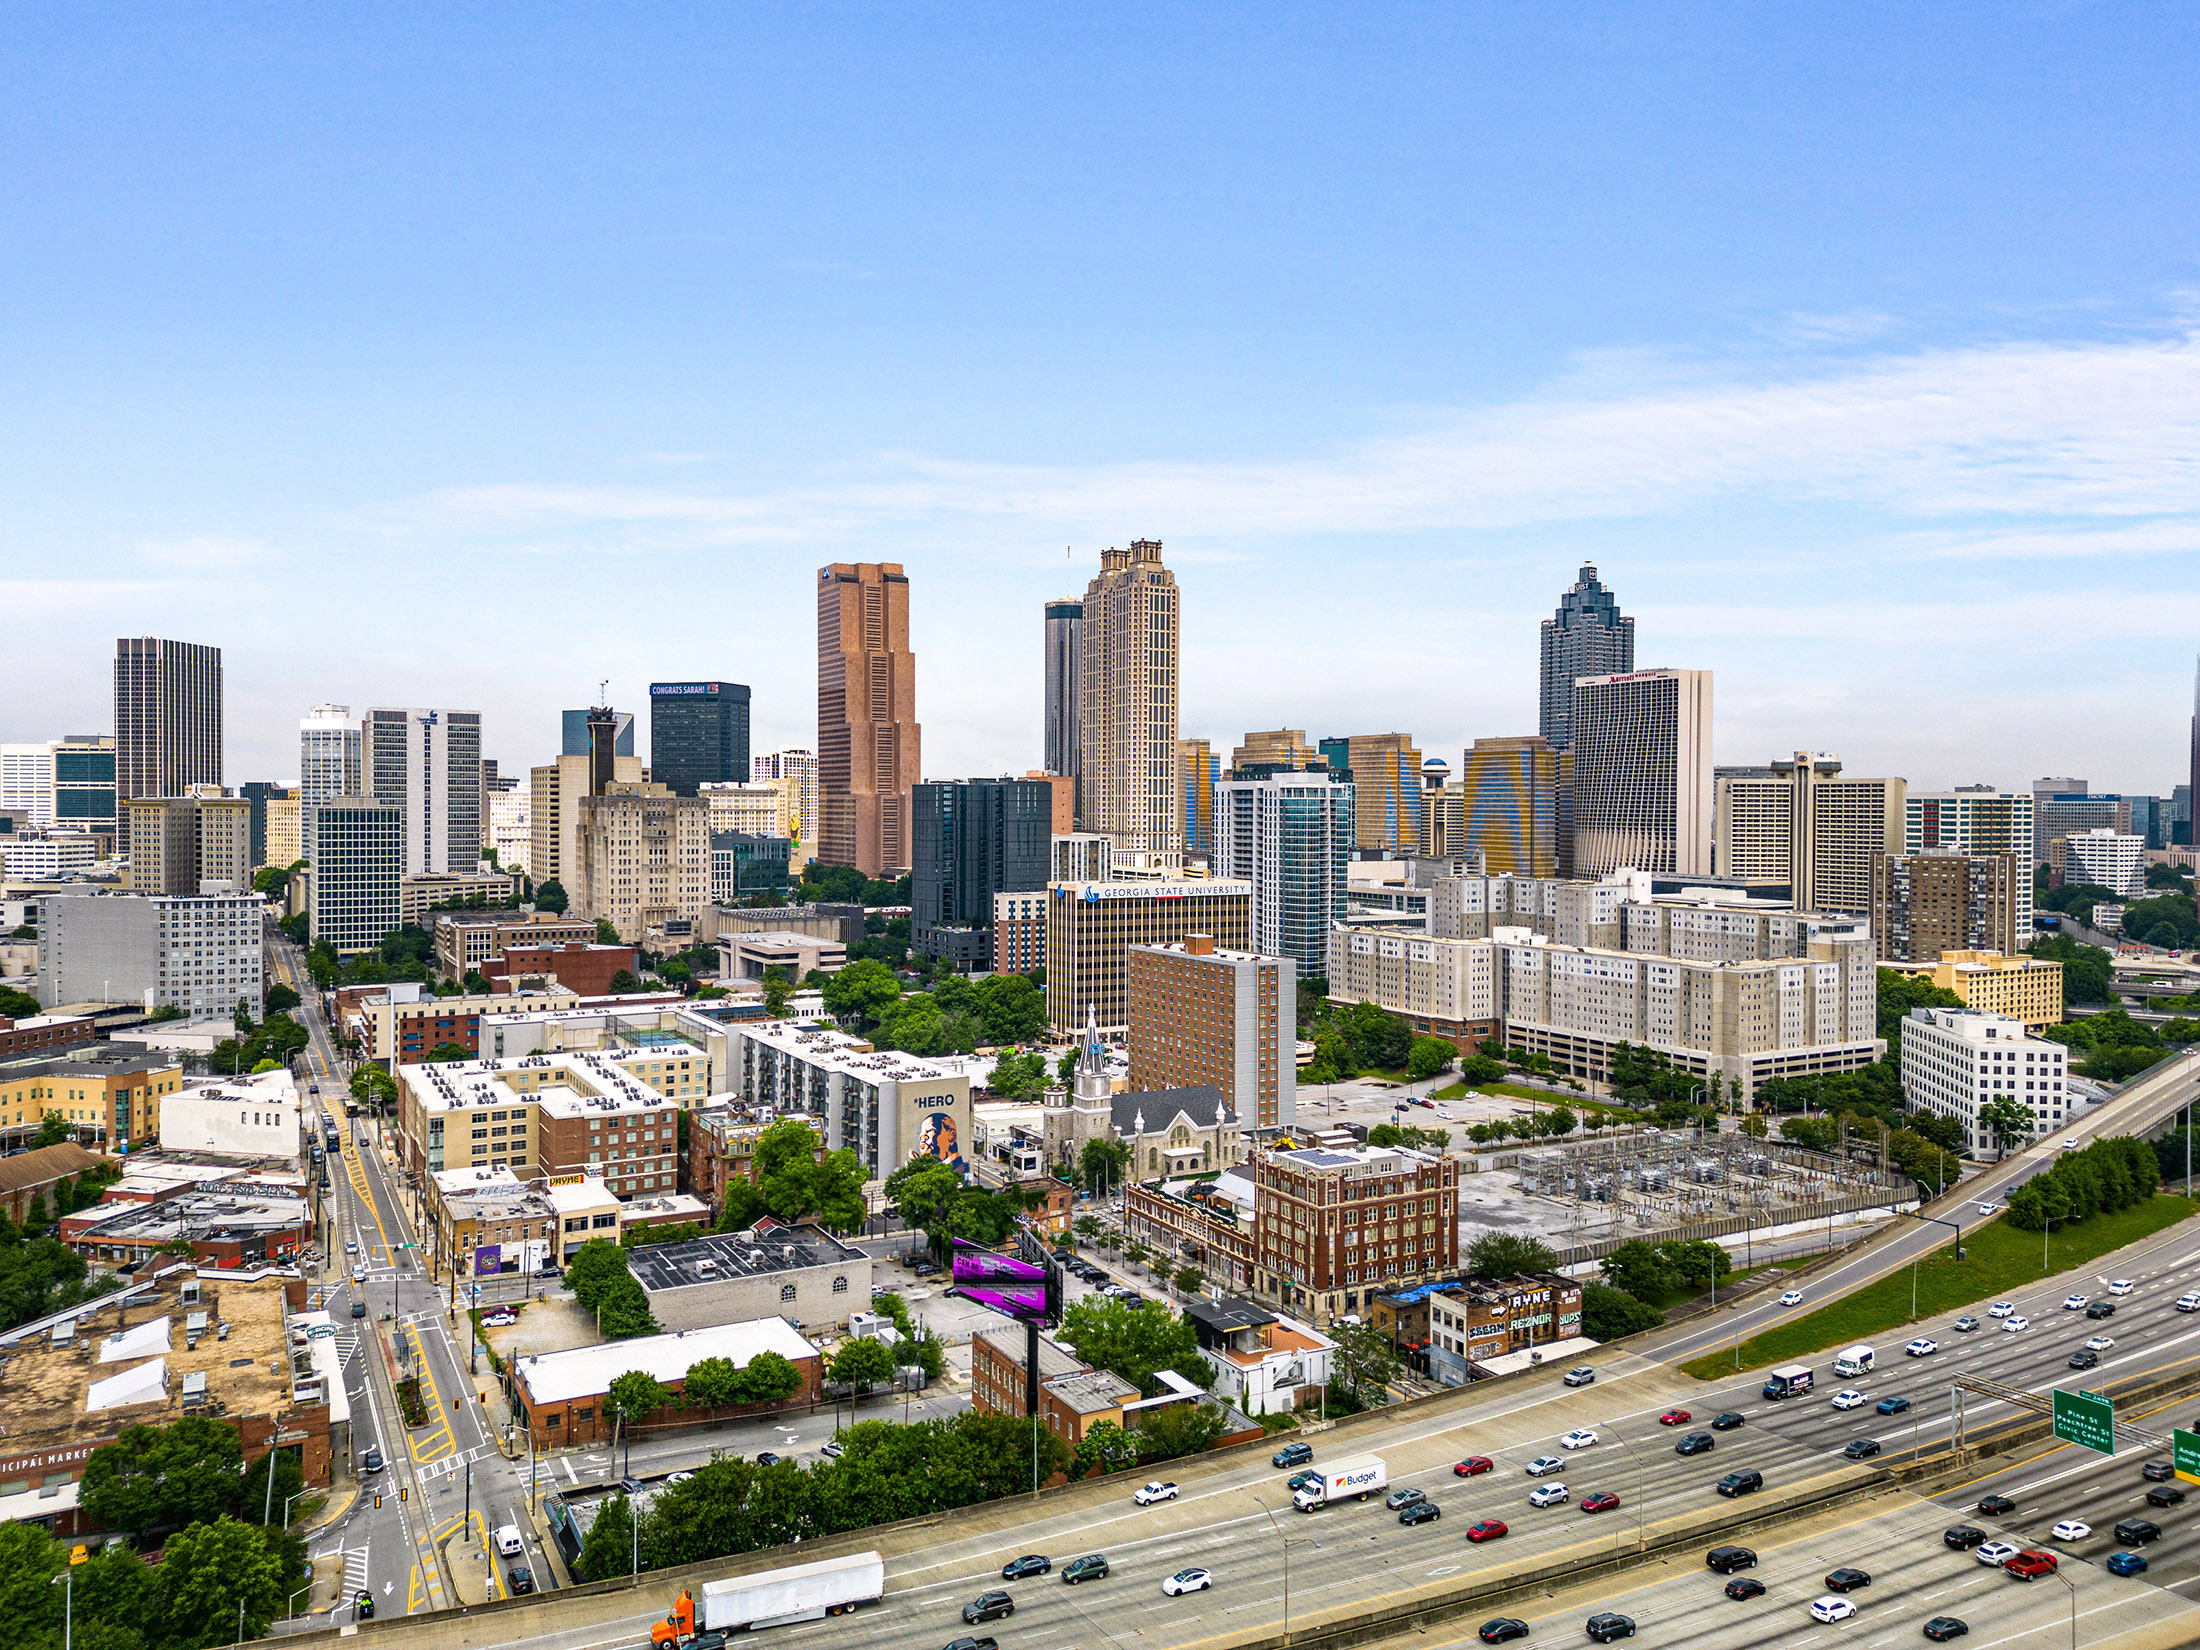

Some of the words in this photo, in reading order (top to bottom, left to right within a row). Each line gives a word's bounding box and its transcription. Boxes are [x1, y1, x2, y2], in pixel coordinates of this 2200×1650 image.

[1609, 674, 1634, 683] Marriott
[652, 686, 682, 694] CONGRATS
[683, 685, 705, 694] SARAH!
[1104, 888, 1150, 897] GEORGIA
[1155, 887, 1183, 895] STATE
[1188, 885, 1245, 895] UNIVERSITY
[2067, 1410, 2086, 1420] Pine
[2089, 1416, 2098, 1425] St
[2057, 1414, 2097, 1432] Peachtree
[2100, 1428, 2110, 1437] St
[2058, 1423, 2078, 1434] Civic
[2081, 1430, 2108, 1444] Center
[2176, 1455, 2196, 1466] John
[1347, 1471, 1377, 1485] Budget
